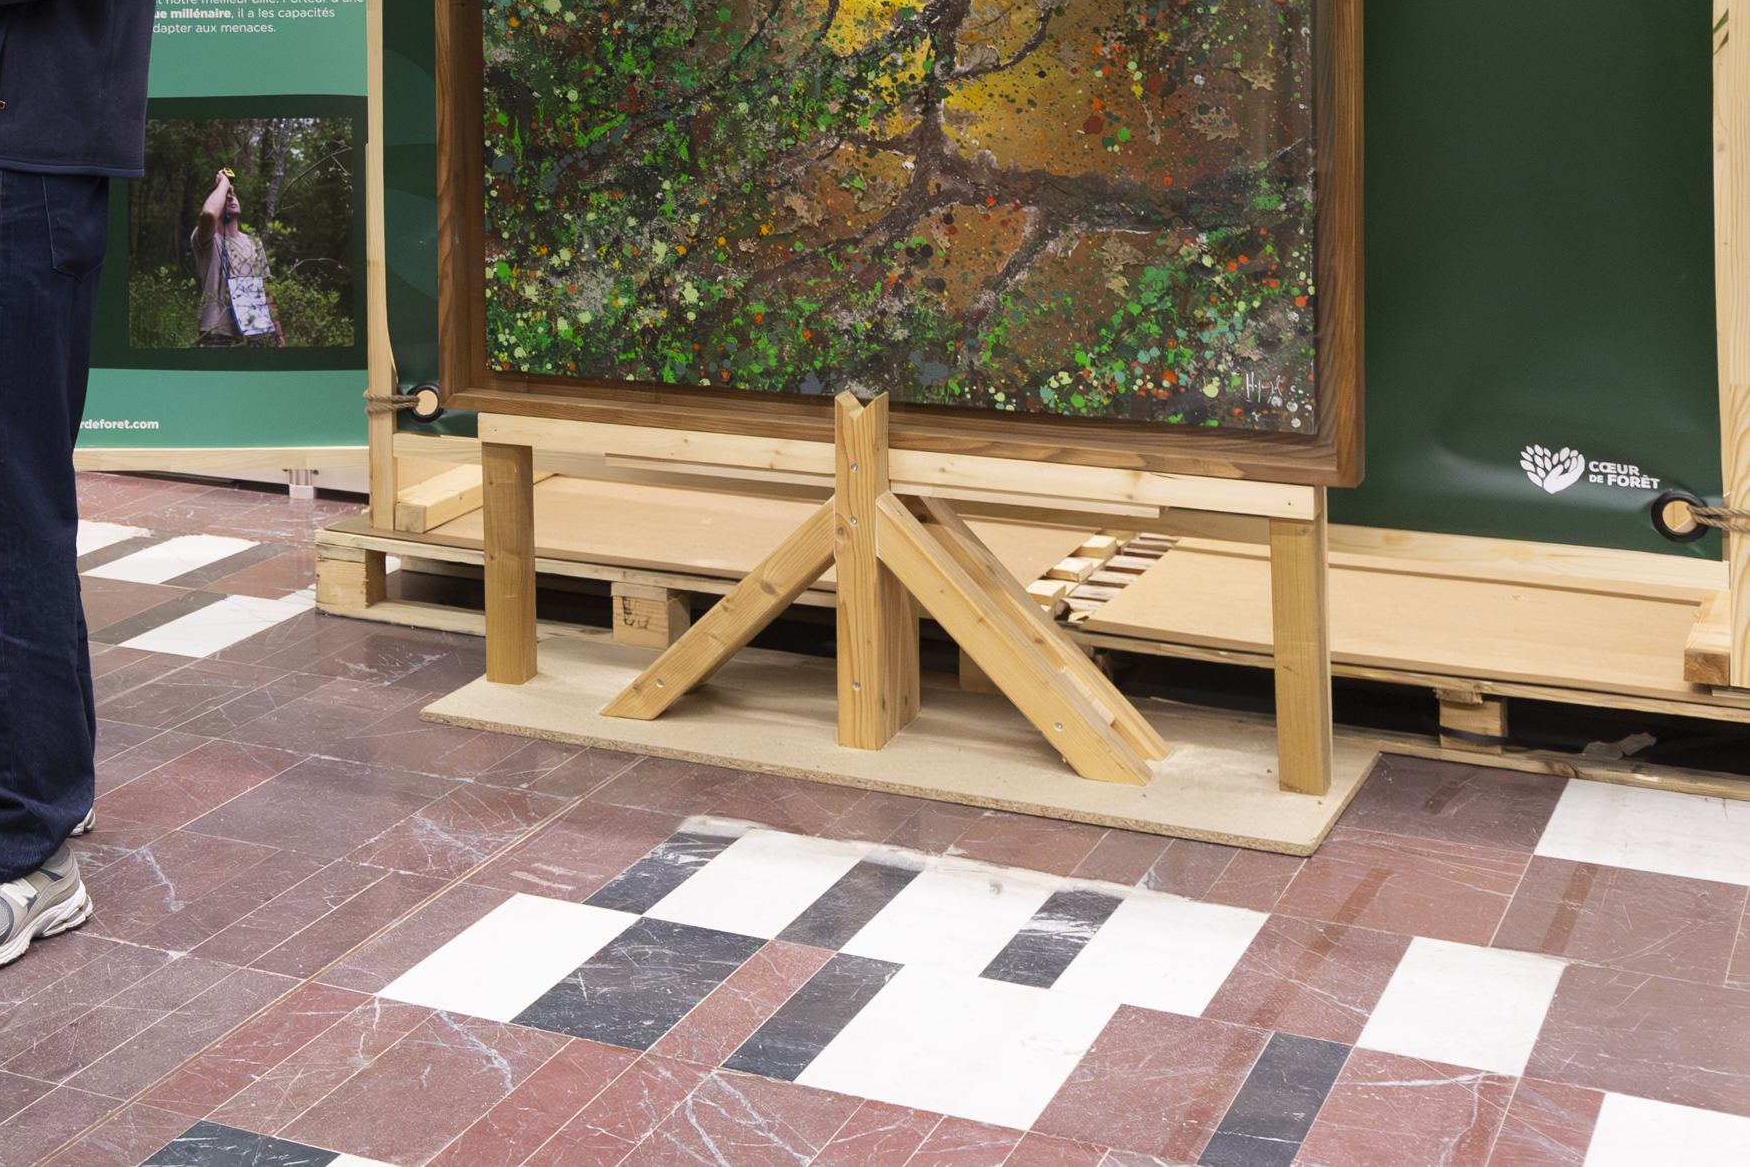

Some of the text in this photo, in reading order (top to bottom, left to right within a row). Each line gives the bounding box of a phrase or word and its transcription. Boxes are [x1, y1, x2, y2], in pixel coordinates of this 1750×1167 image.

[170, 8, 234, 19] millénaire,
[238, 8, 244, 18] il
[258, 8, 274, 18] les
[278, 7, 335, 19] capacités
[154, 23, 276, 34] dapter aux menaces.
[80, 419, 159, 429] rdeforet.com
[1589, 461, 1640, 477] CŒUR
[1589, 472, 1660, 489] DE FORÊT
